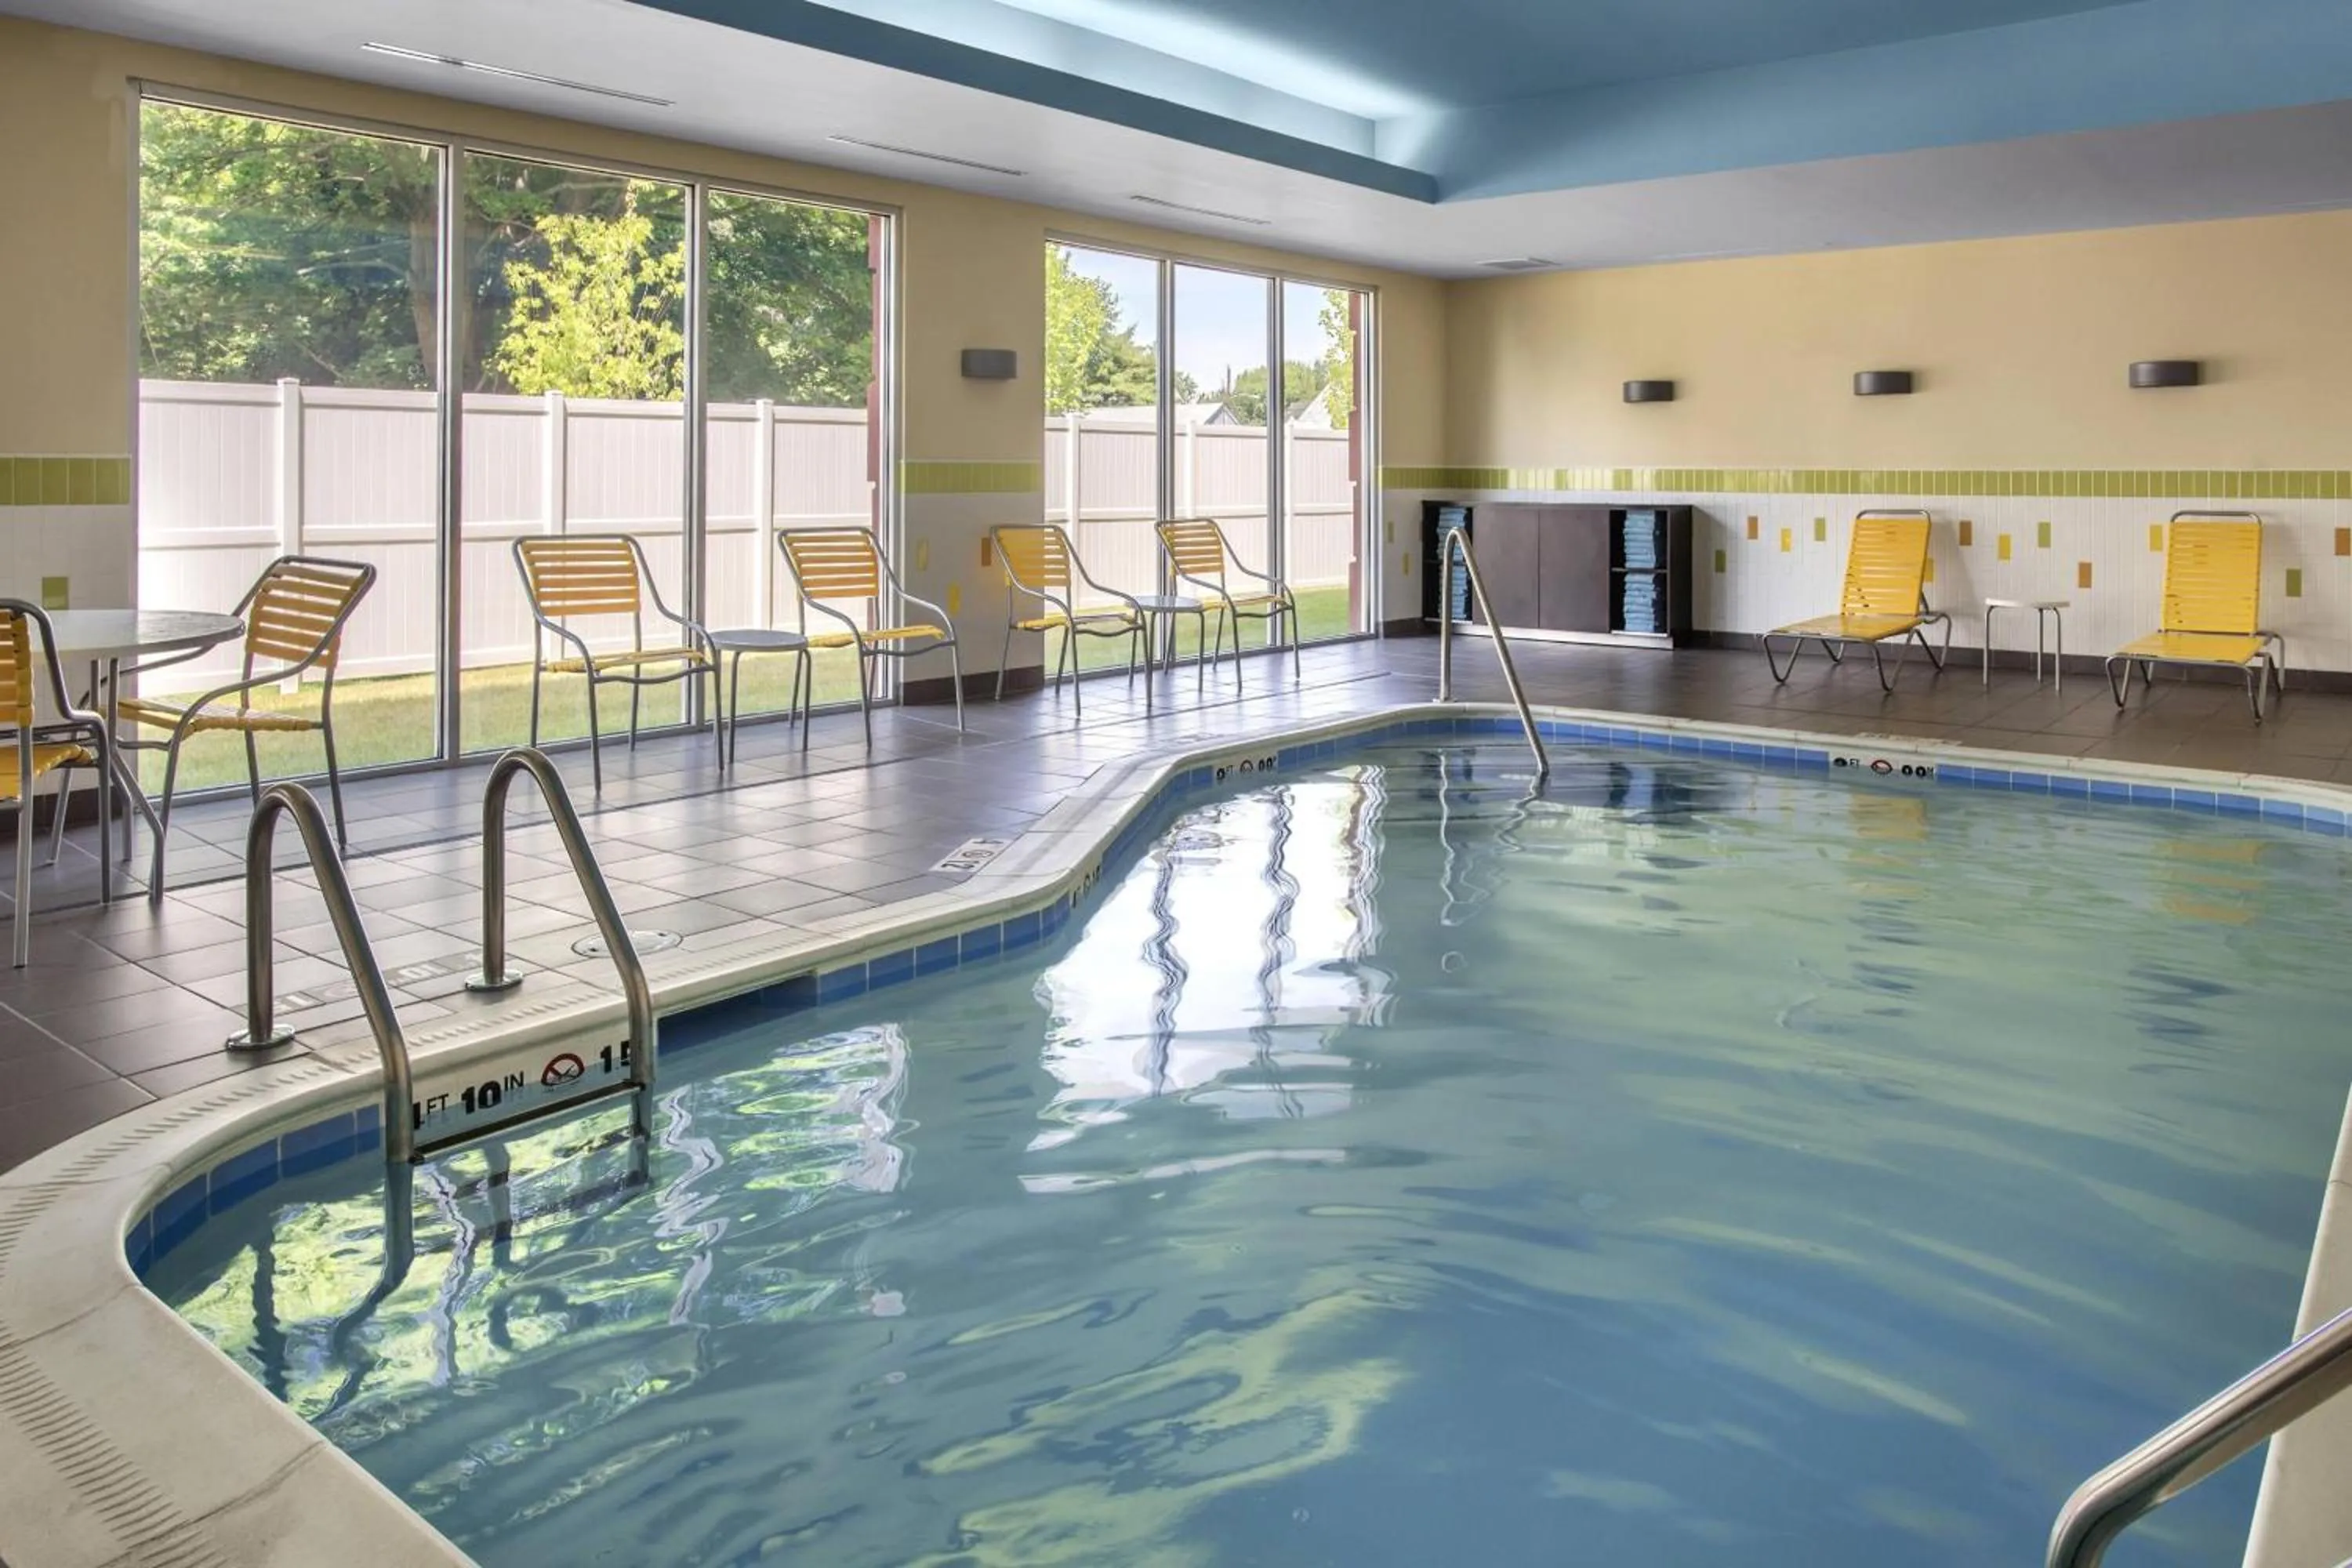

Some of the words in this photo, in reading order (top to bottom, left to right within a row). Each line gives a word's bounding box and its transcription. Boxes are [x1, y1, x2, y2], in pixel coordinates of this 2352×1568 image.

[426, 1093, 449, 1115] FT
[461, 1080, 502, 1114] 10
[503, 1070, 524, 1091] IN
